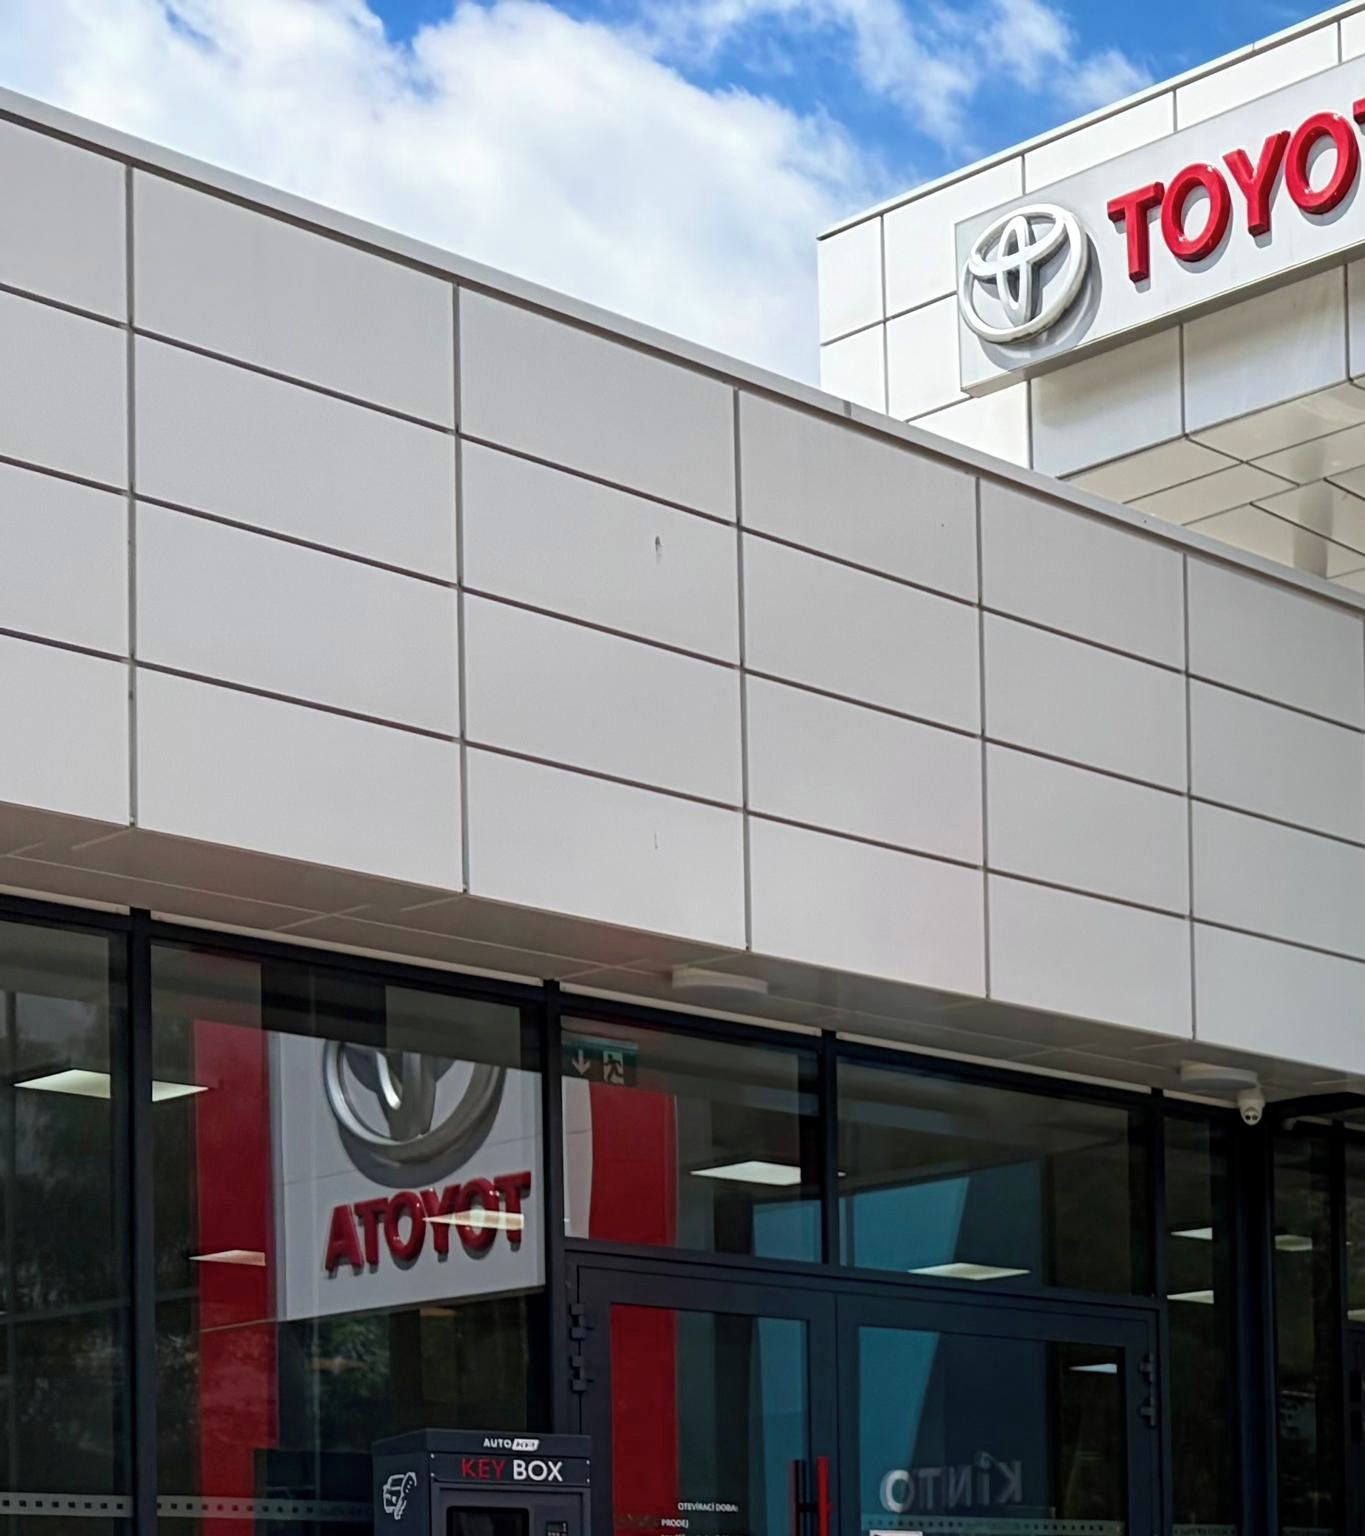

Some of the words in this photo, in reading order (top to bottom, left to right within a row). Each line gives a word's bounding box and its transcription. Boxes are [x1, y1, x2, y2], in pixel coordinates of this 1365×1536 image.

[483, 1438, 512, 1449] AUTO
[460, 1457, 507, 1479] KEY
[513, 1460, 563, 1482] BOX
